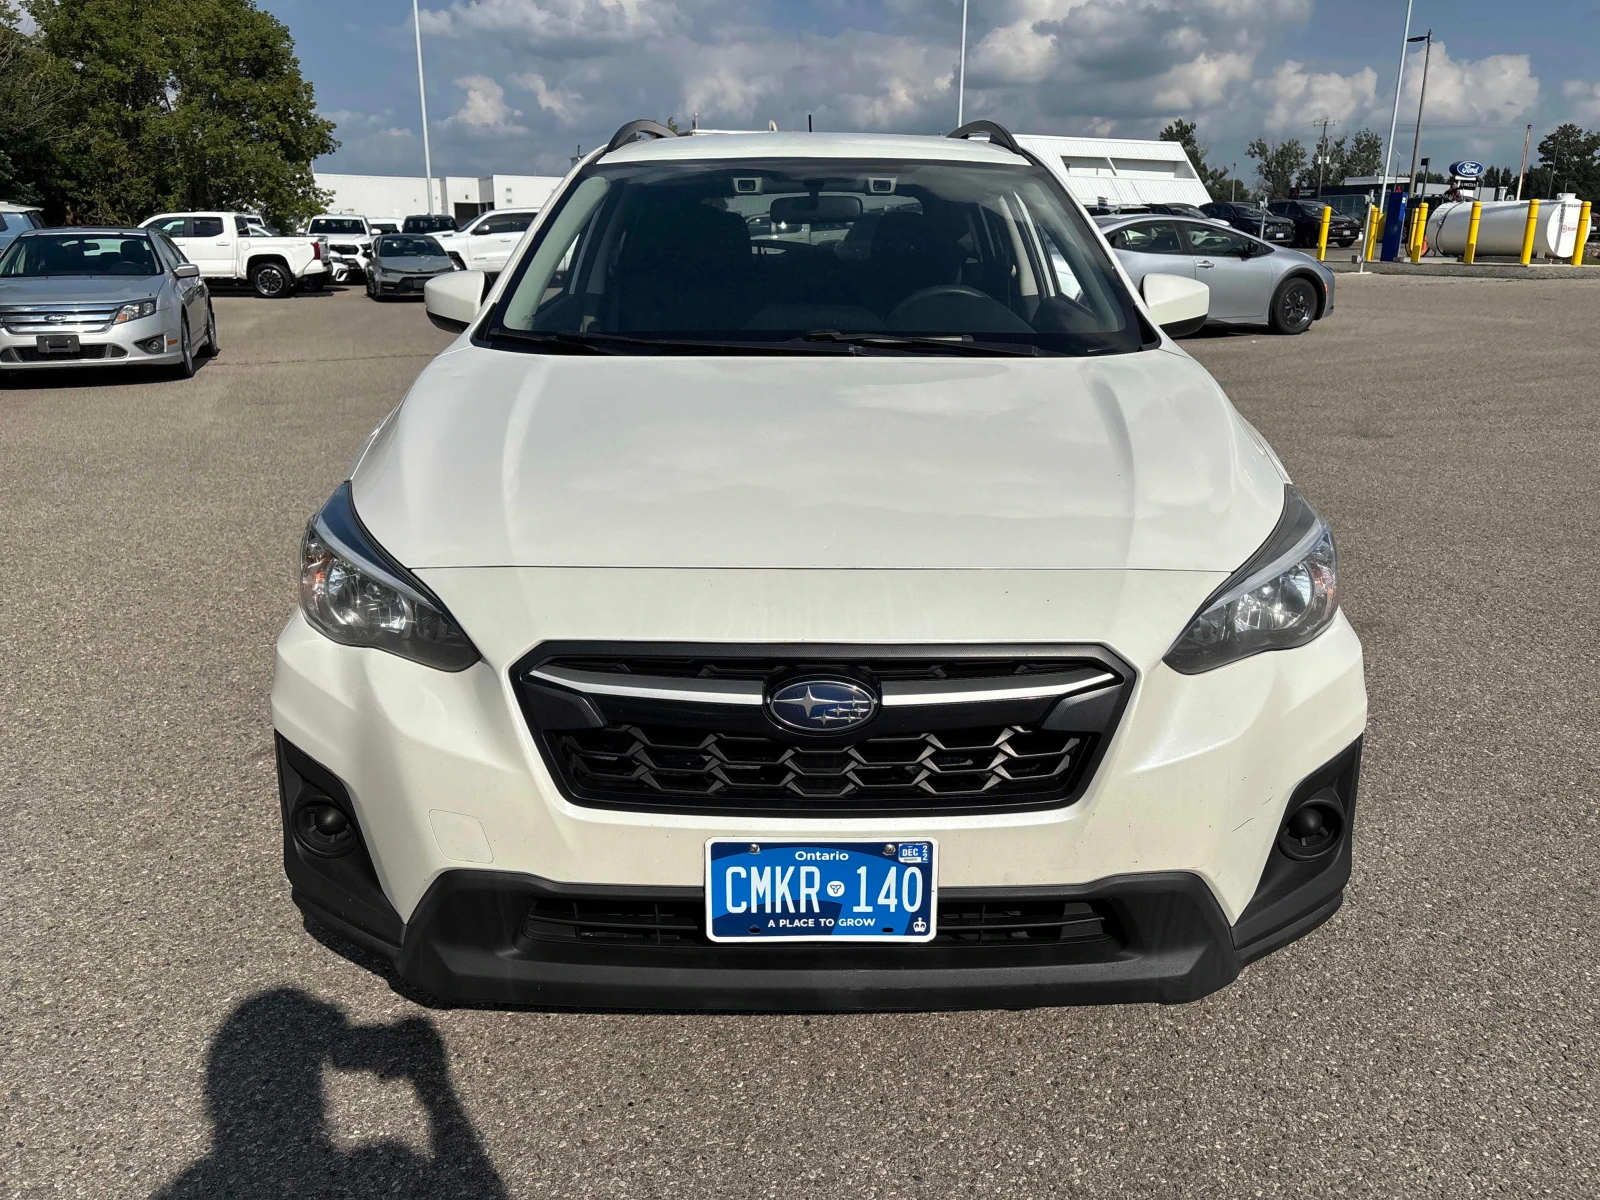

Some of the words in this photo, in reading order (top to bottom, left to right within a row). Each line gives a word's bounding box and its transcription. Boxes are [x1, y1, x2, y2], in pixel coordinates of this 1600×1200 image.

[1462, 163, 1479, 173] Ford
[795, 850, 849, 861] Ontario
[902, 848, 919, 857] DEC
[725, 866, 821, 914] CMKR
[852, 866, 923, 913] 140
[767, 919, 776, 928] A
[779, 918, 815, 928] PLACE
[819, 918, 835, 927] TO
[838, 918, 876, 927] GROW
